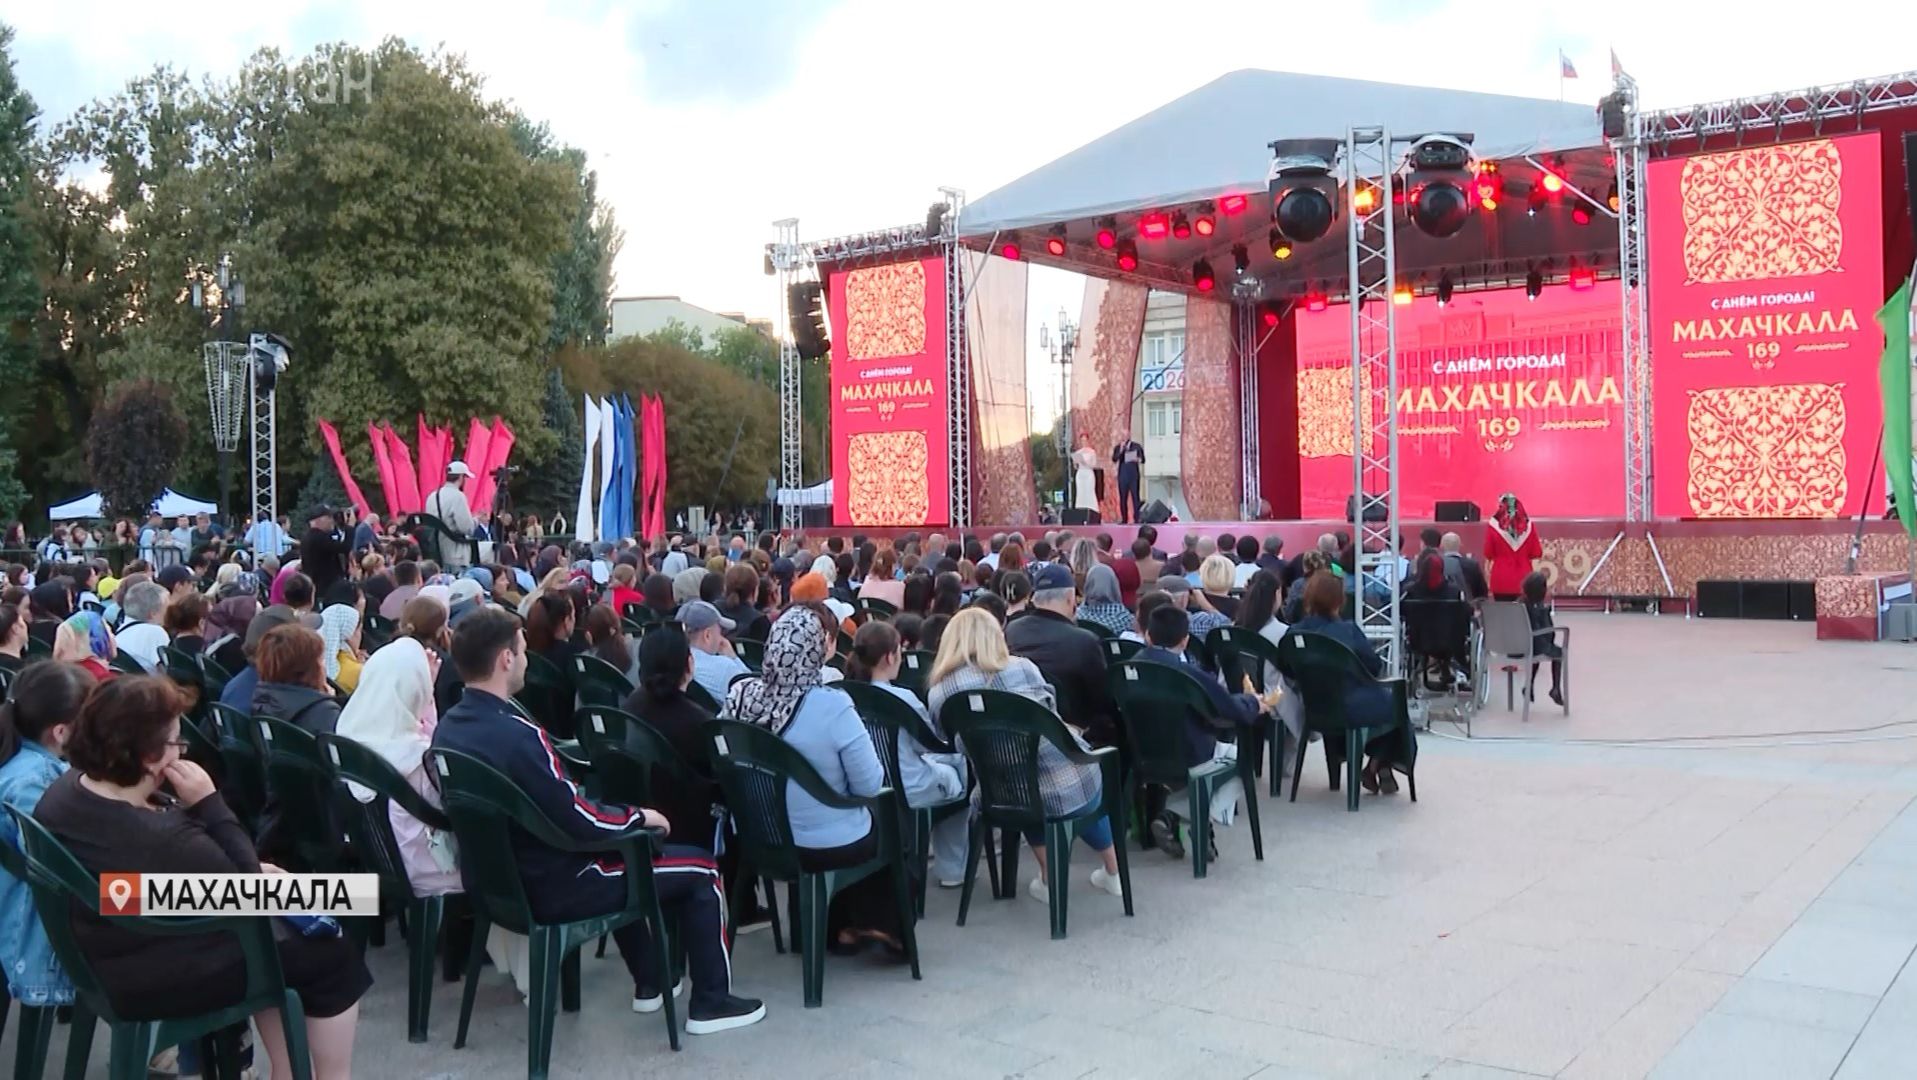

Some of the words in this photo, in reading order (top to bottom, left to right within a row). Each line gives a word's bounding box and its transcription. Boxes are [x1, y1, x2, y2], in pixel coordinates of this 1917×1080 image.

[1711, 299, 1721, 310] С
[1722, 294, 1757, 309] ДНЁМ
[1761, 291, 1815, 306] ГОРОДА!
[1672, 309, 1859, 342] МАХАЧКАЛА
[1746, 342, 1780, 359] 169
[1433, 361, 1443, 375] С
[1446, 356, 1492, 374] ДНЁМ
[1497, 352, 1566, 371] ГОРОДА!
[841, 378, 934, 401] МАХАЧКАЛА
[1143, 371, 1185, 390] 2026
[1383, 376, 1624, 414] МАХАЧКАЛА
[1477, 417, 1521, 437] 169
